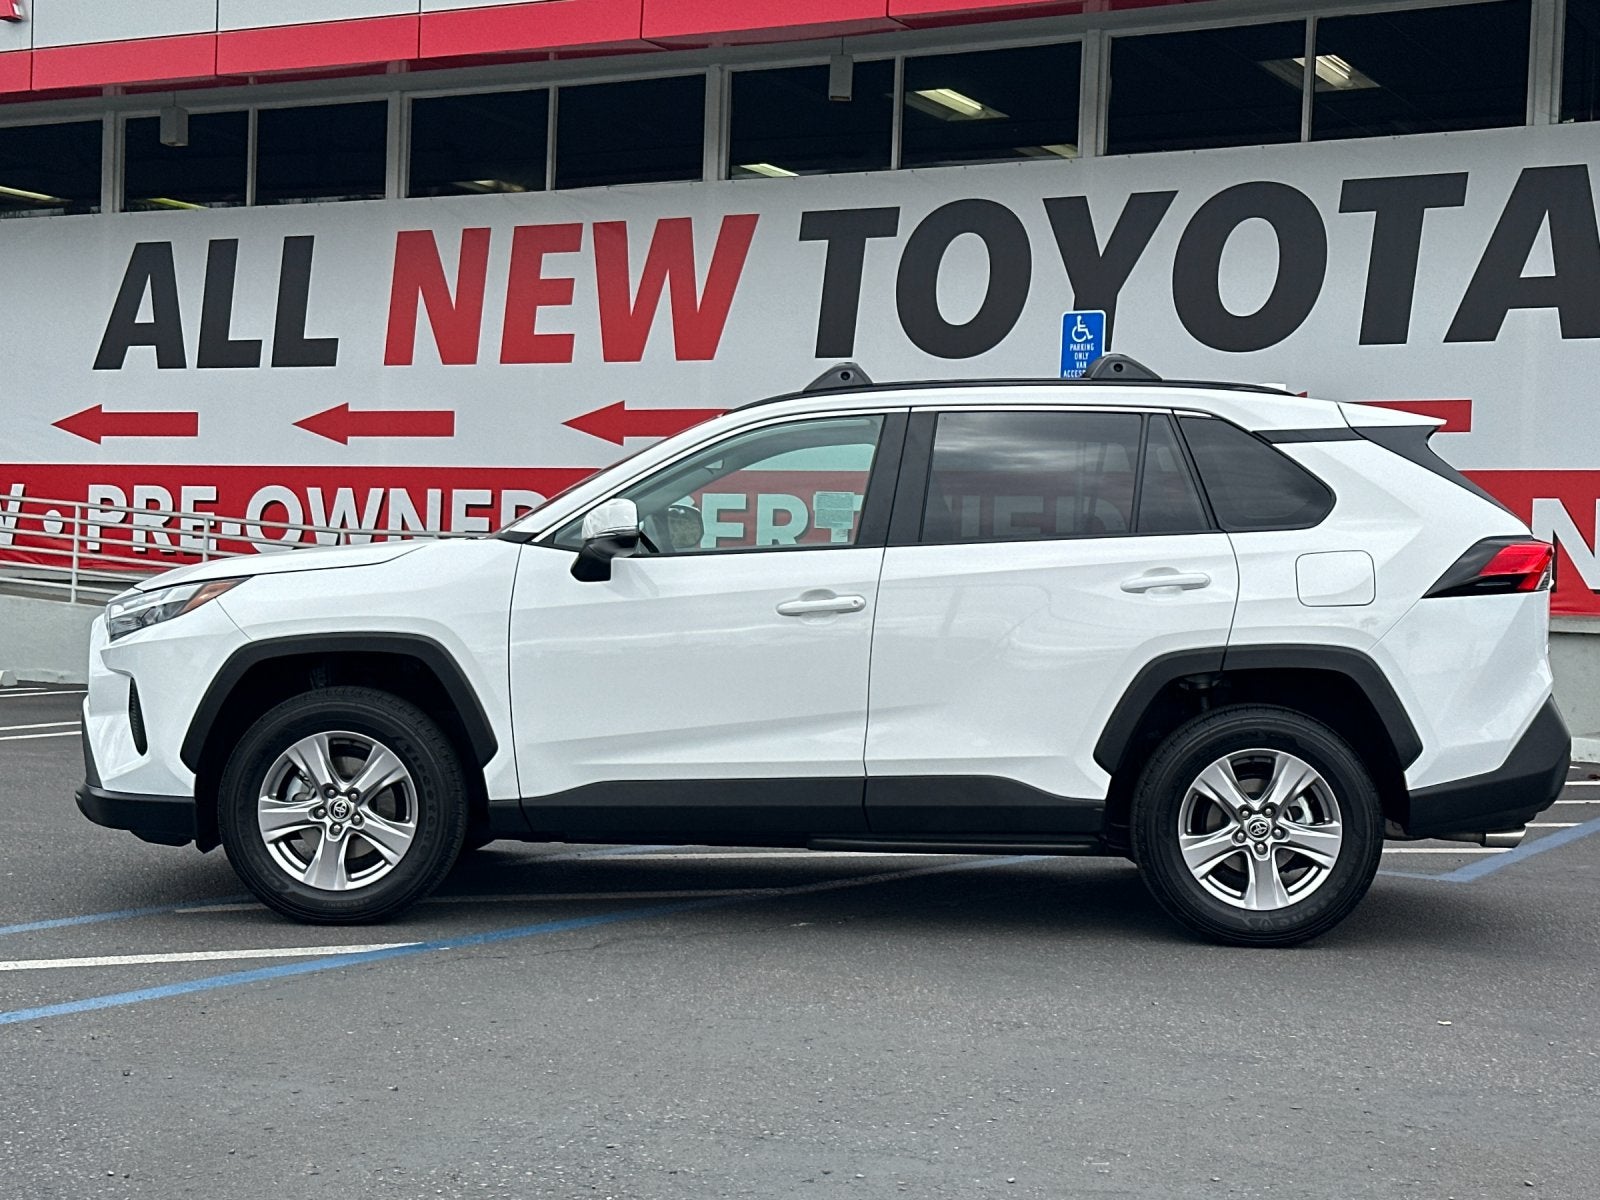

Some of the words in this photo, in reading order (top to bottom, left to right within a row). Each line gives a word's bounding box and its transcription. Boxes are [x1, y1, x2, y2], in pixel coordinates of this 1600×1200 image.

[92, 235, 338, 370] ALL
[383, 213, 760, 366] NEW
[798, 163, 1600, 360] TOYOTA
[1069, 342, 1095, 352] PARKING
[1074, 352, 1089, 360] ONLY
[1076, 361, 1087, 369] VAN
